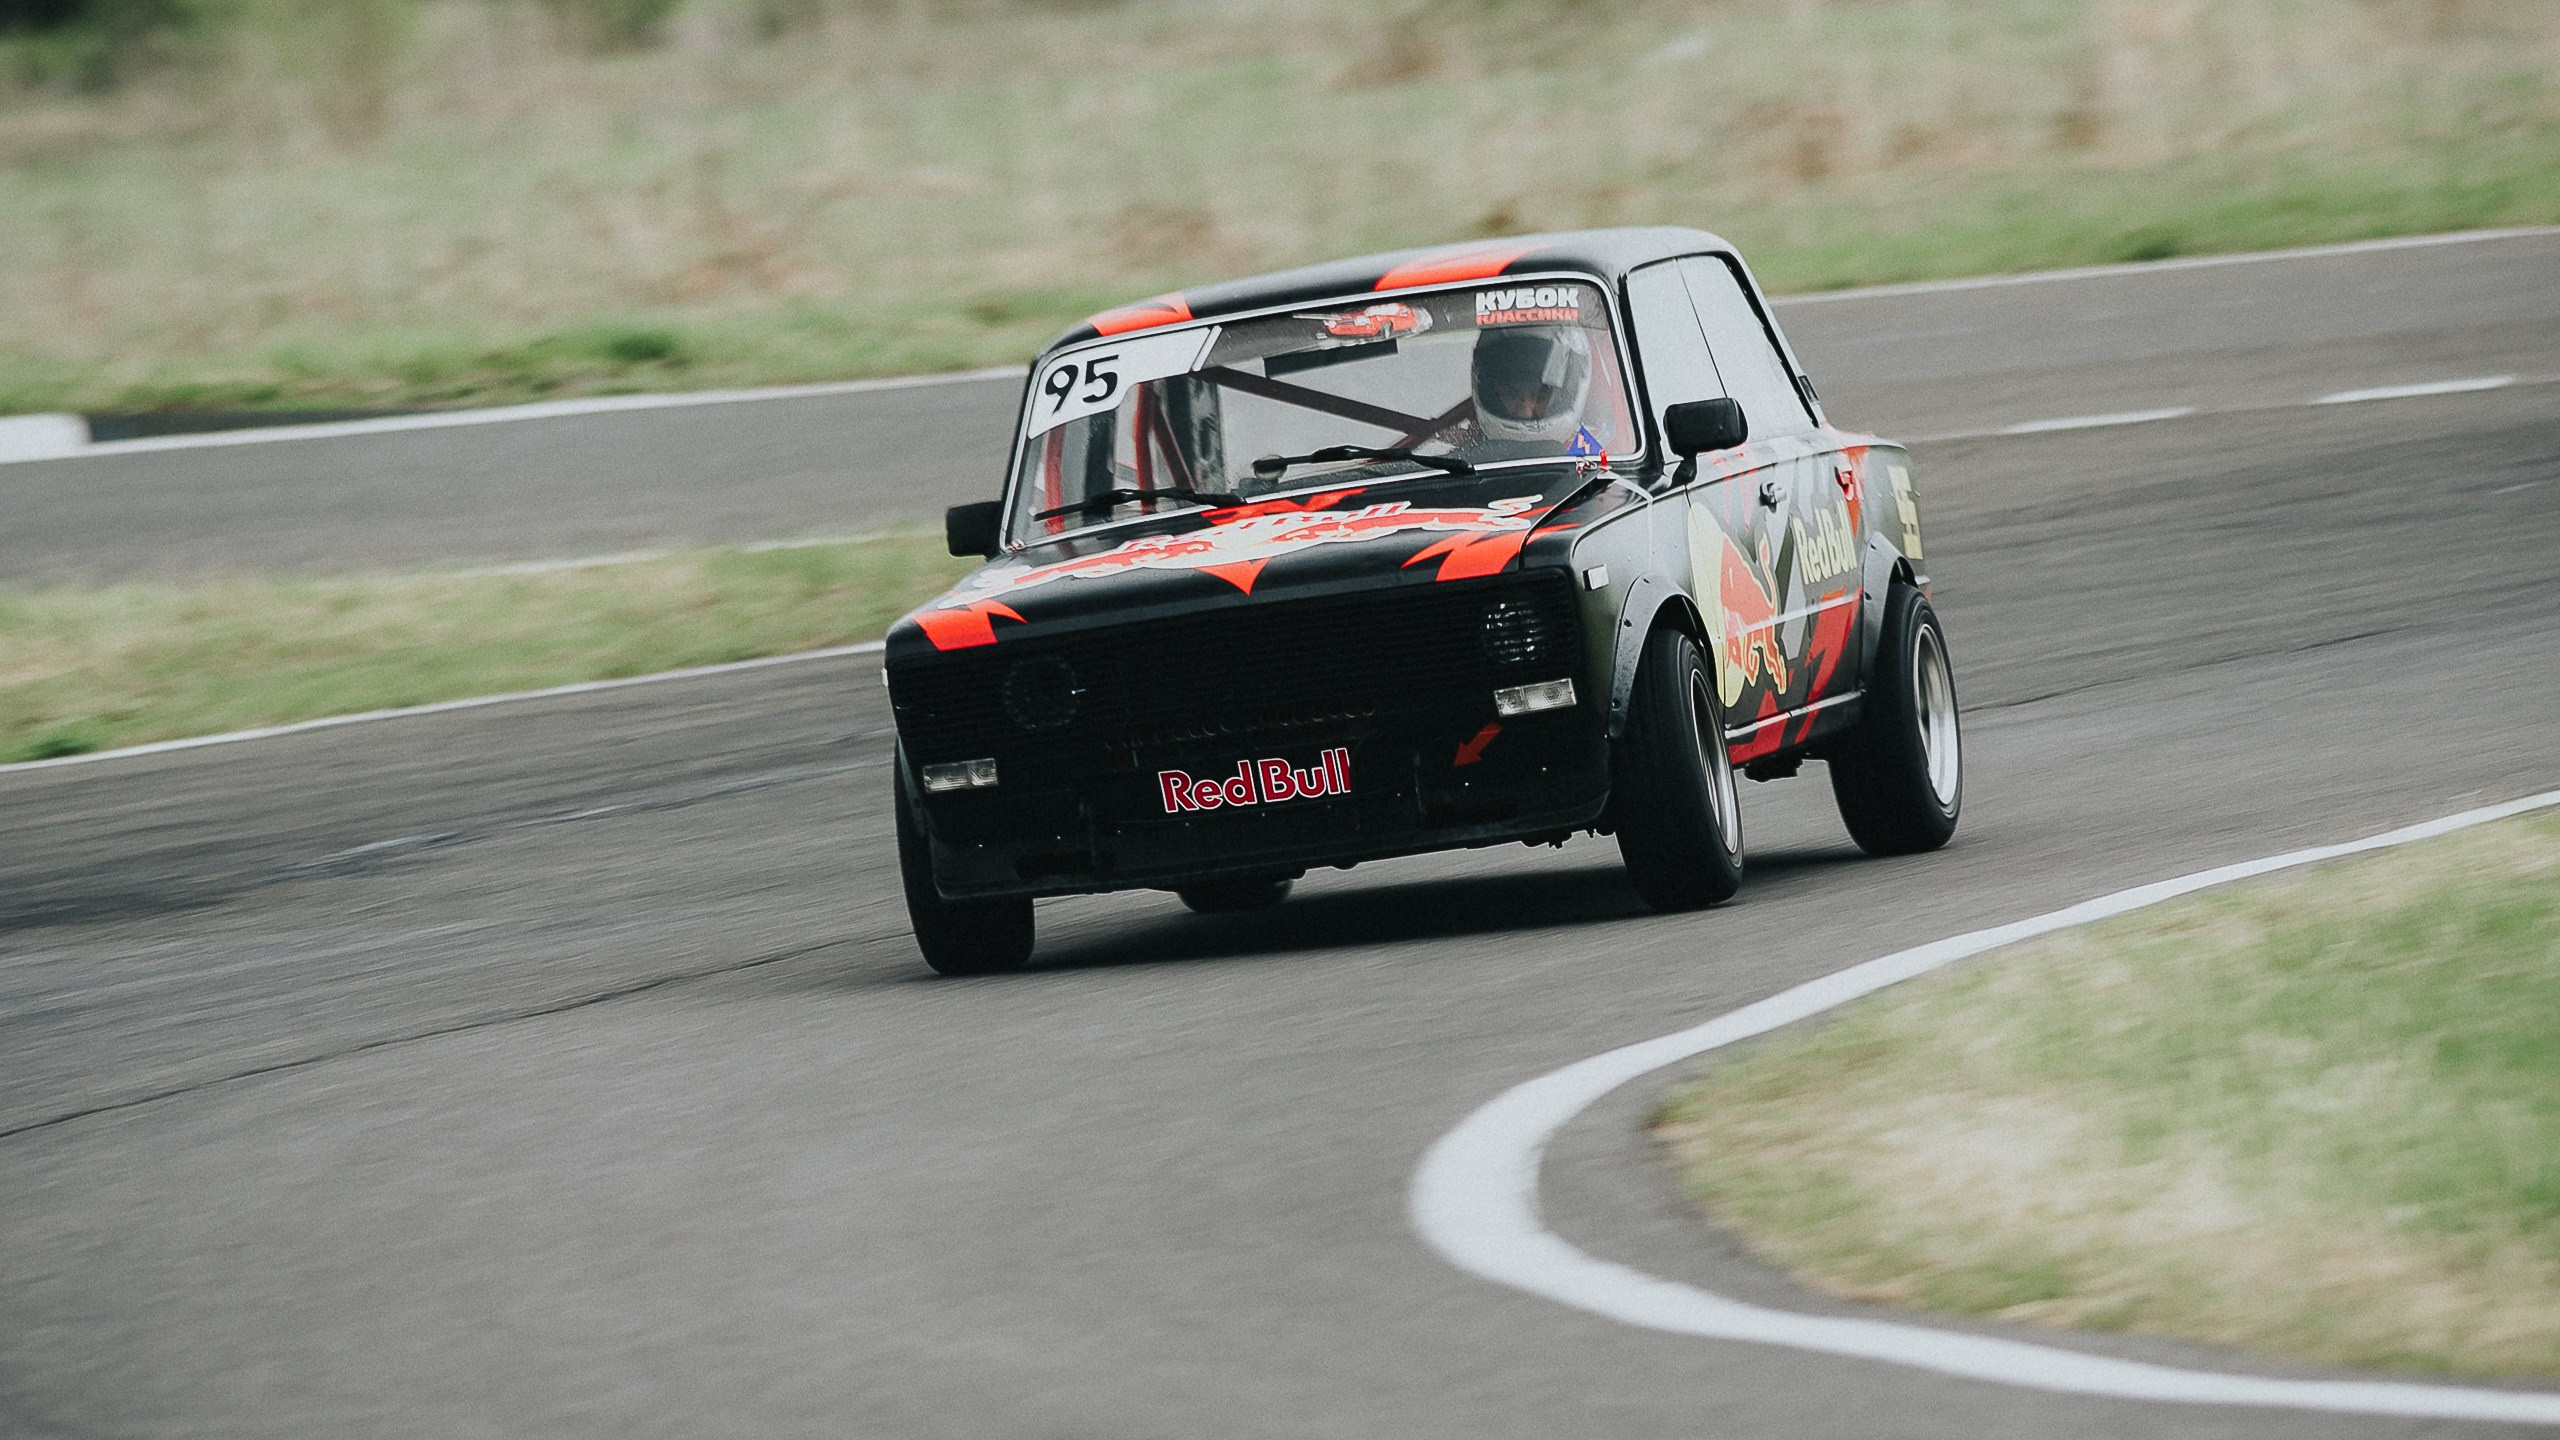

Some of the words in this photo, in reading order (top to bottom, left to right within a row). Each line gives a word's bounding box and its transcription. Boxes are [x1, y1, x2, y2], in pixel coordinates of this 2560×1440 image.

[1475, 287, 1579, 316] КУБОК
[1476, 308, 1579, 326] КЛАССИКИ
[1045, 354, 1119, 415] 95
[1158, 760, 1258, 813] Red
[1258, 747, 1352, 803] Bull
